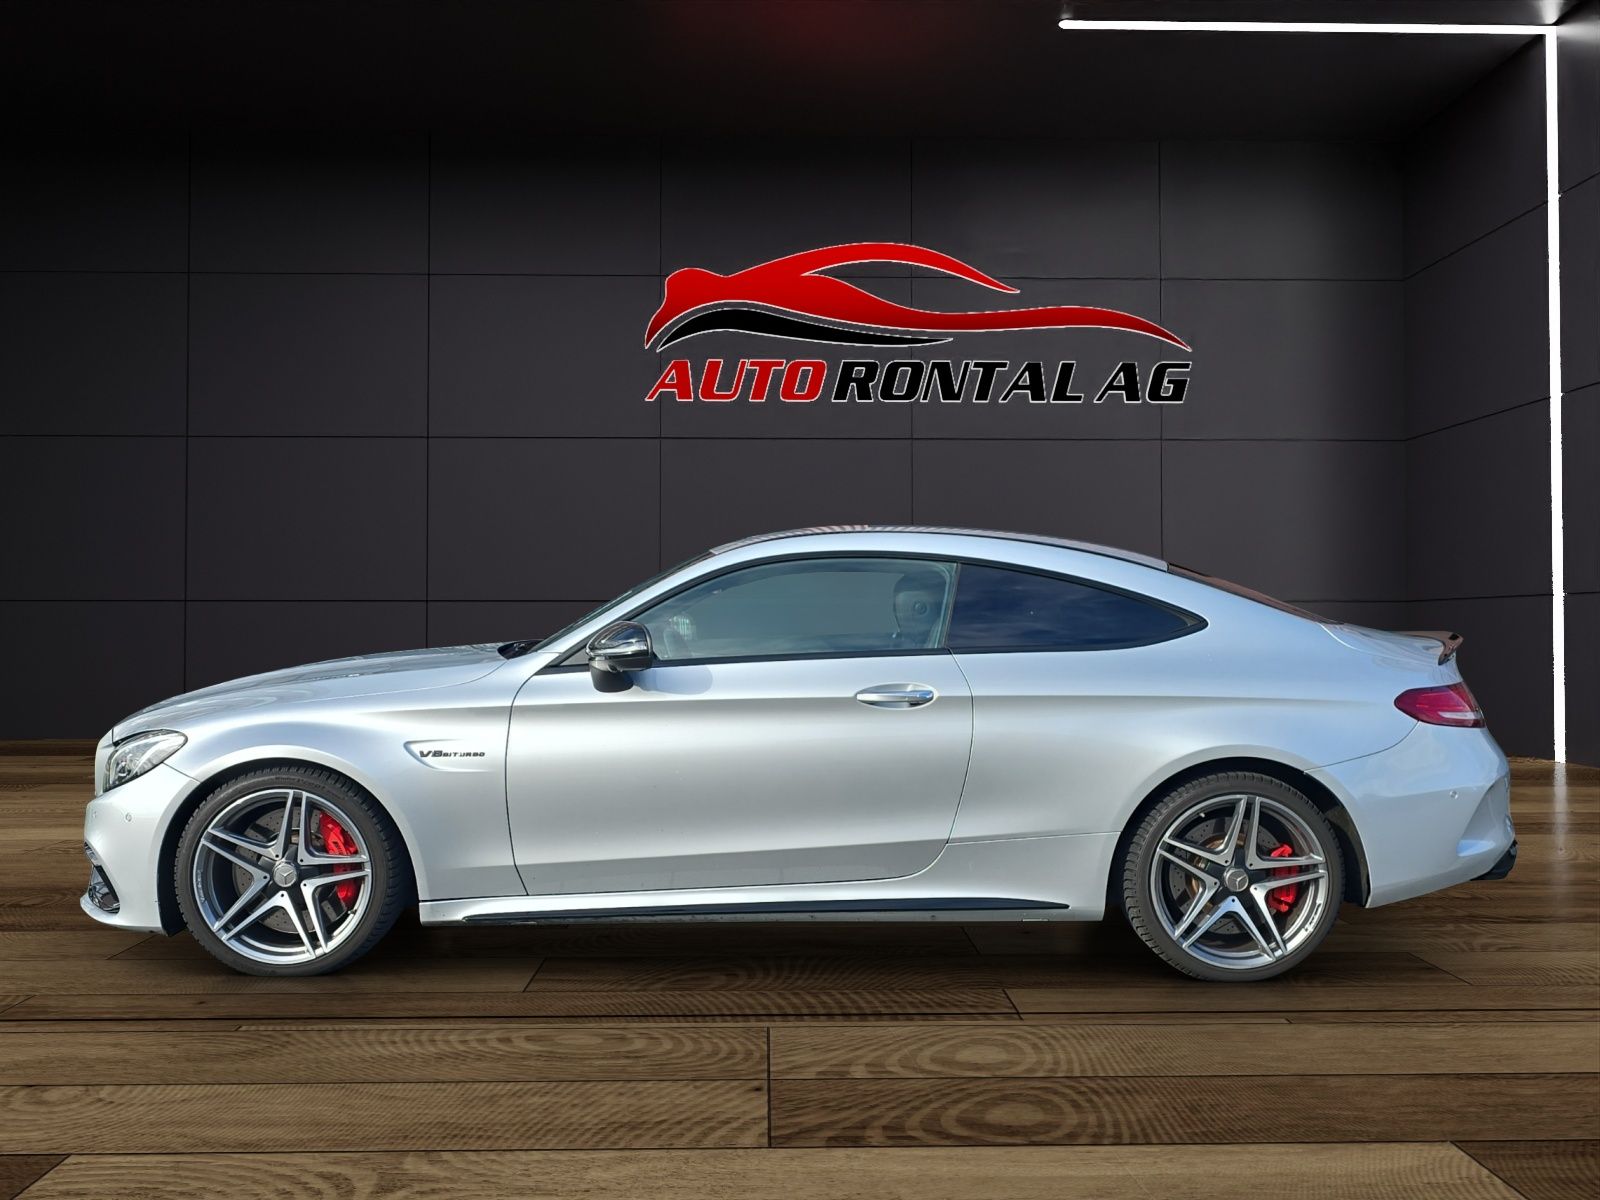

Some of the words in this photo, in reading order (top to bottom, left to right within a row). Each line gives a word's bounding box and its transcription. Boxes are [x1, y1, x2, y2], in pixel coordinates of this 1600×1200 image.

[645, 358, 826, 402] AUTO
[831, 359, 1083, 403] RONTAL
[1093, 360, 1192, 403] AG
